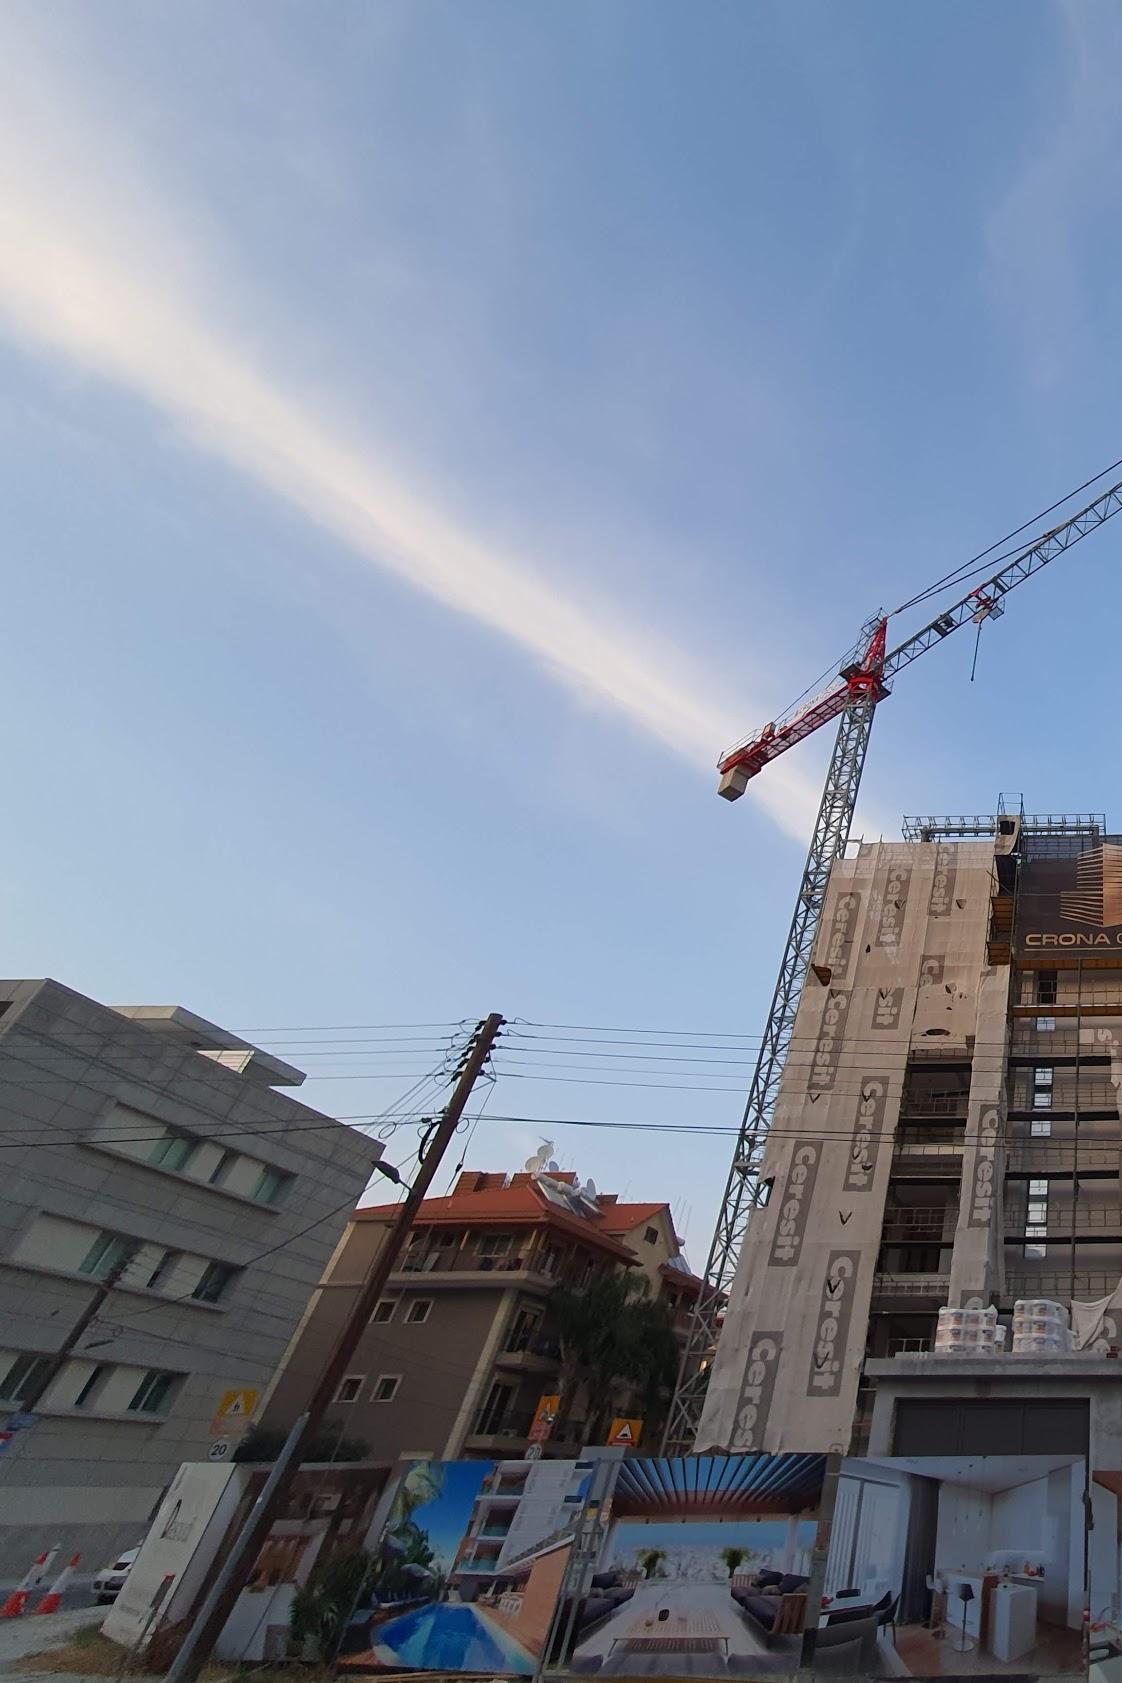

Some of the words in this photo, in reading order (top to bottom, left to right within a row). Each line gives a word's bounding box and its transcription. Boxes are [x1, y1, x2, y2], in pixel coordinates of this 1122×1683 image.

[828, 895, 856, 975] Ceresit
[880, 870, 907, 943] Ceresit
[1025, 933, 1111, 946] CRONA
[810, 995, 847, 1086] Ceresit
[848, 1081, 883, 1187] Ceresit
[973, 1110, 998, 1221] Ceresit
[773, 1146, 816, 1260] Ceresit
[812, 1256, 854, 1390] Ceresit
[733, 1338, 777, 1450] Ceres
[211, 1444, 227, 1456] 20
